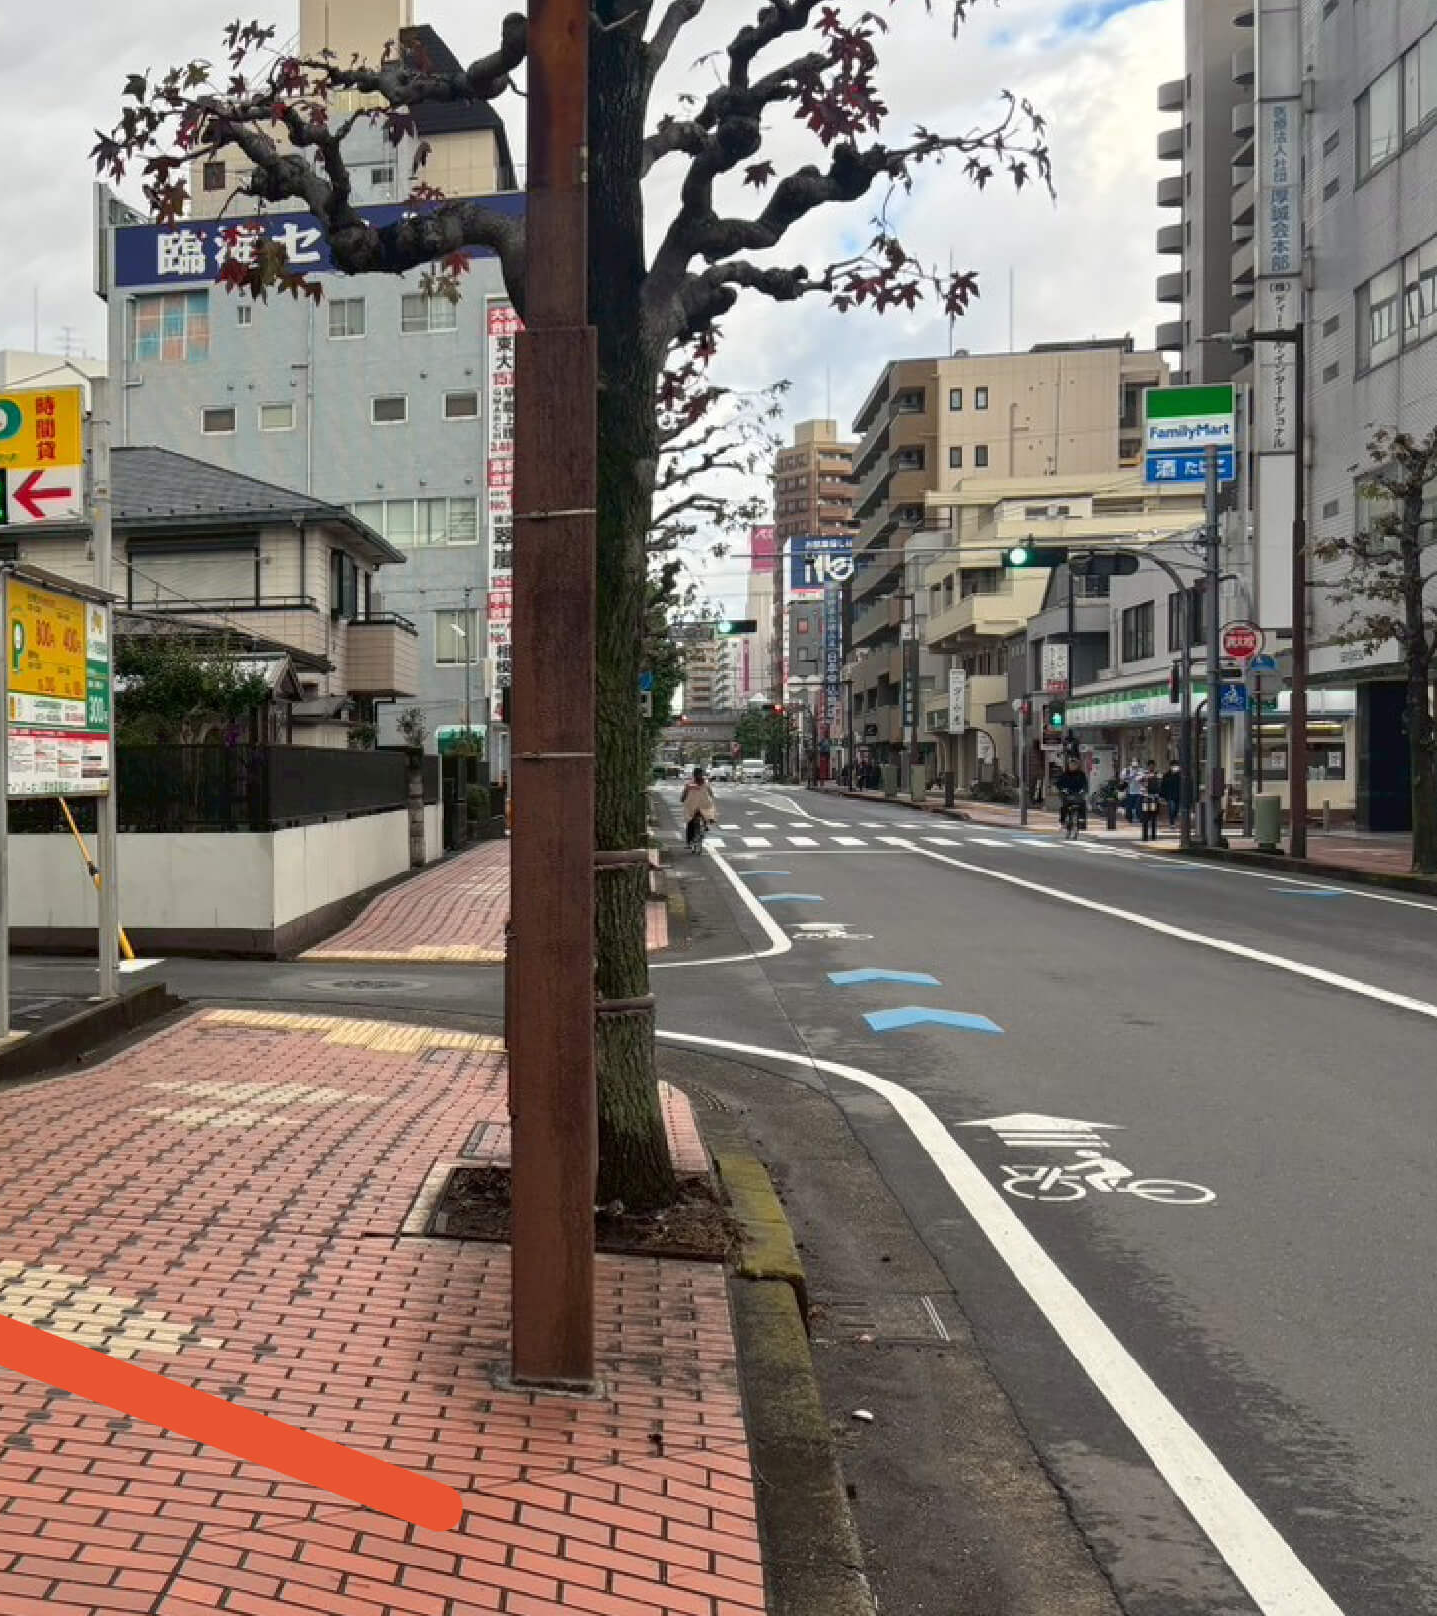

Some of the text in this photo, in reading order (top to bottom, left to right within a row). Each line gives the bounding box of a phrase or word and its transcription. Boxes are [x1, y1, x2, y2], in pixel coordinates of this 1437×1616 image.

[36, 395, 56, 461] 時間貸
[1149, 424, 1230, 440] FamilyMart
